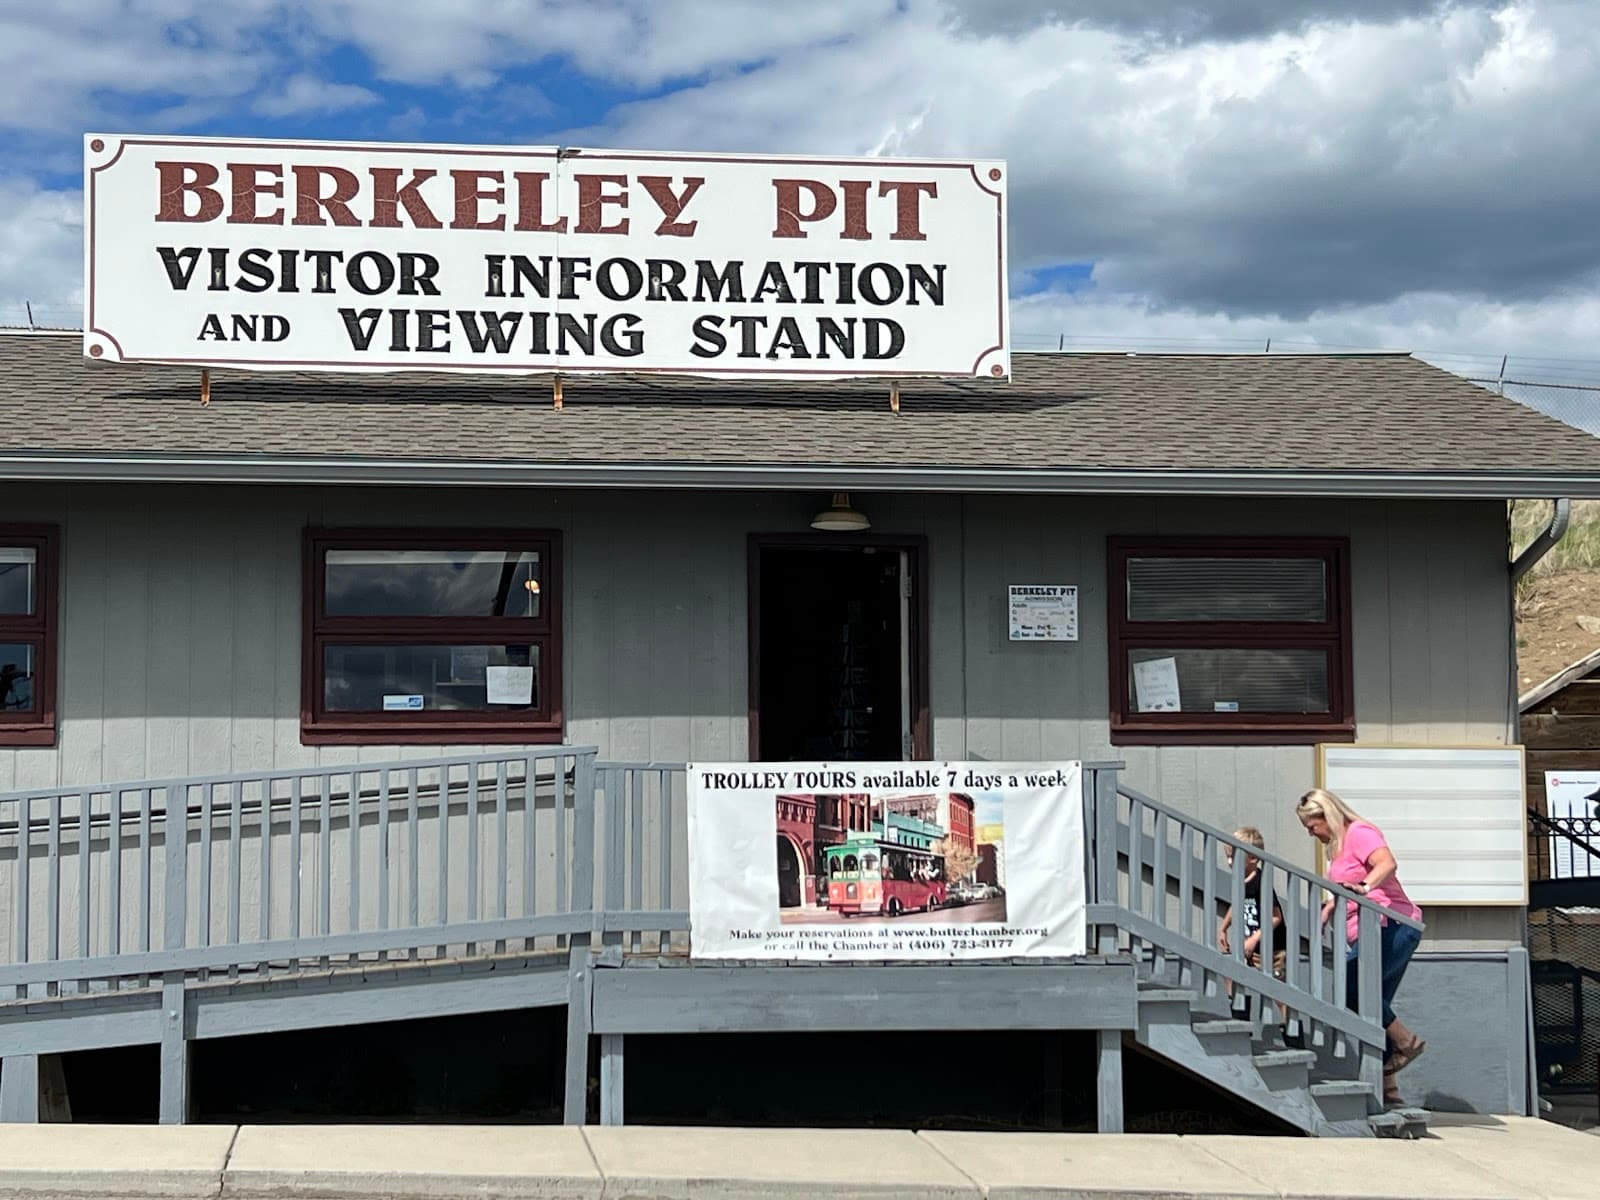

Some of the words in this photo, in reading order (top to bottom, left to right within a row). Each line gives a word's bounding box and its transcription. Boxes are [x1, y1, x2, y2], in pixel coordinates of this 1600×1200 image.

[155, 160, 705, 238] BERKELEY
[772, 178, 938, 241] PIT
[156, 246, 441, 296] VISITOR
[485, 254, 947, 306] INFORMATION
[197, 313, 290, 342] AND
[338, 307, 645, 357] VIEWING
[690, 314, 906, 360] STAND
[1060, 587, 1076, 596] PIT
[702, 772, 788, 789] TROLLEY
[794, 771, 857, 788] TOURS
[863, 769, 940, 788] available
[947, 771, 957, 788] 7
[964, 770, 1002, 791] days
[1008, 775, 1019, 788] a
[1025, 770, 1067, 788] week
[730, 929, 762, 940] Make
[766, 930, 795, 941] your
[799, 928, 873, 939] reservations
[878, 928, 889, 938] at
[893, 926, 1048, 938] www.buttechamber.org
[764, 943, 778, 951] or
[782, 940, 804, 951] call
[808, 940, 829, 951] the
[833, 940, 890, 951] Chamber
[892, 940, 903, 950] at
[909, 939, 945, 950] (406)
[952, 938, 1014, 950] 723-3177
